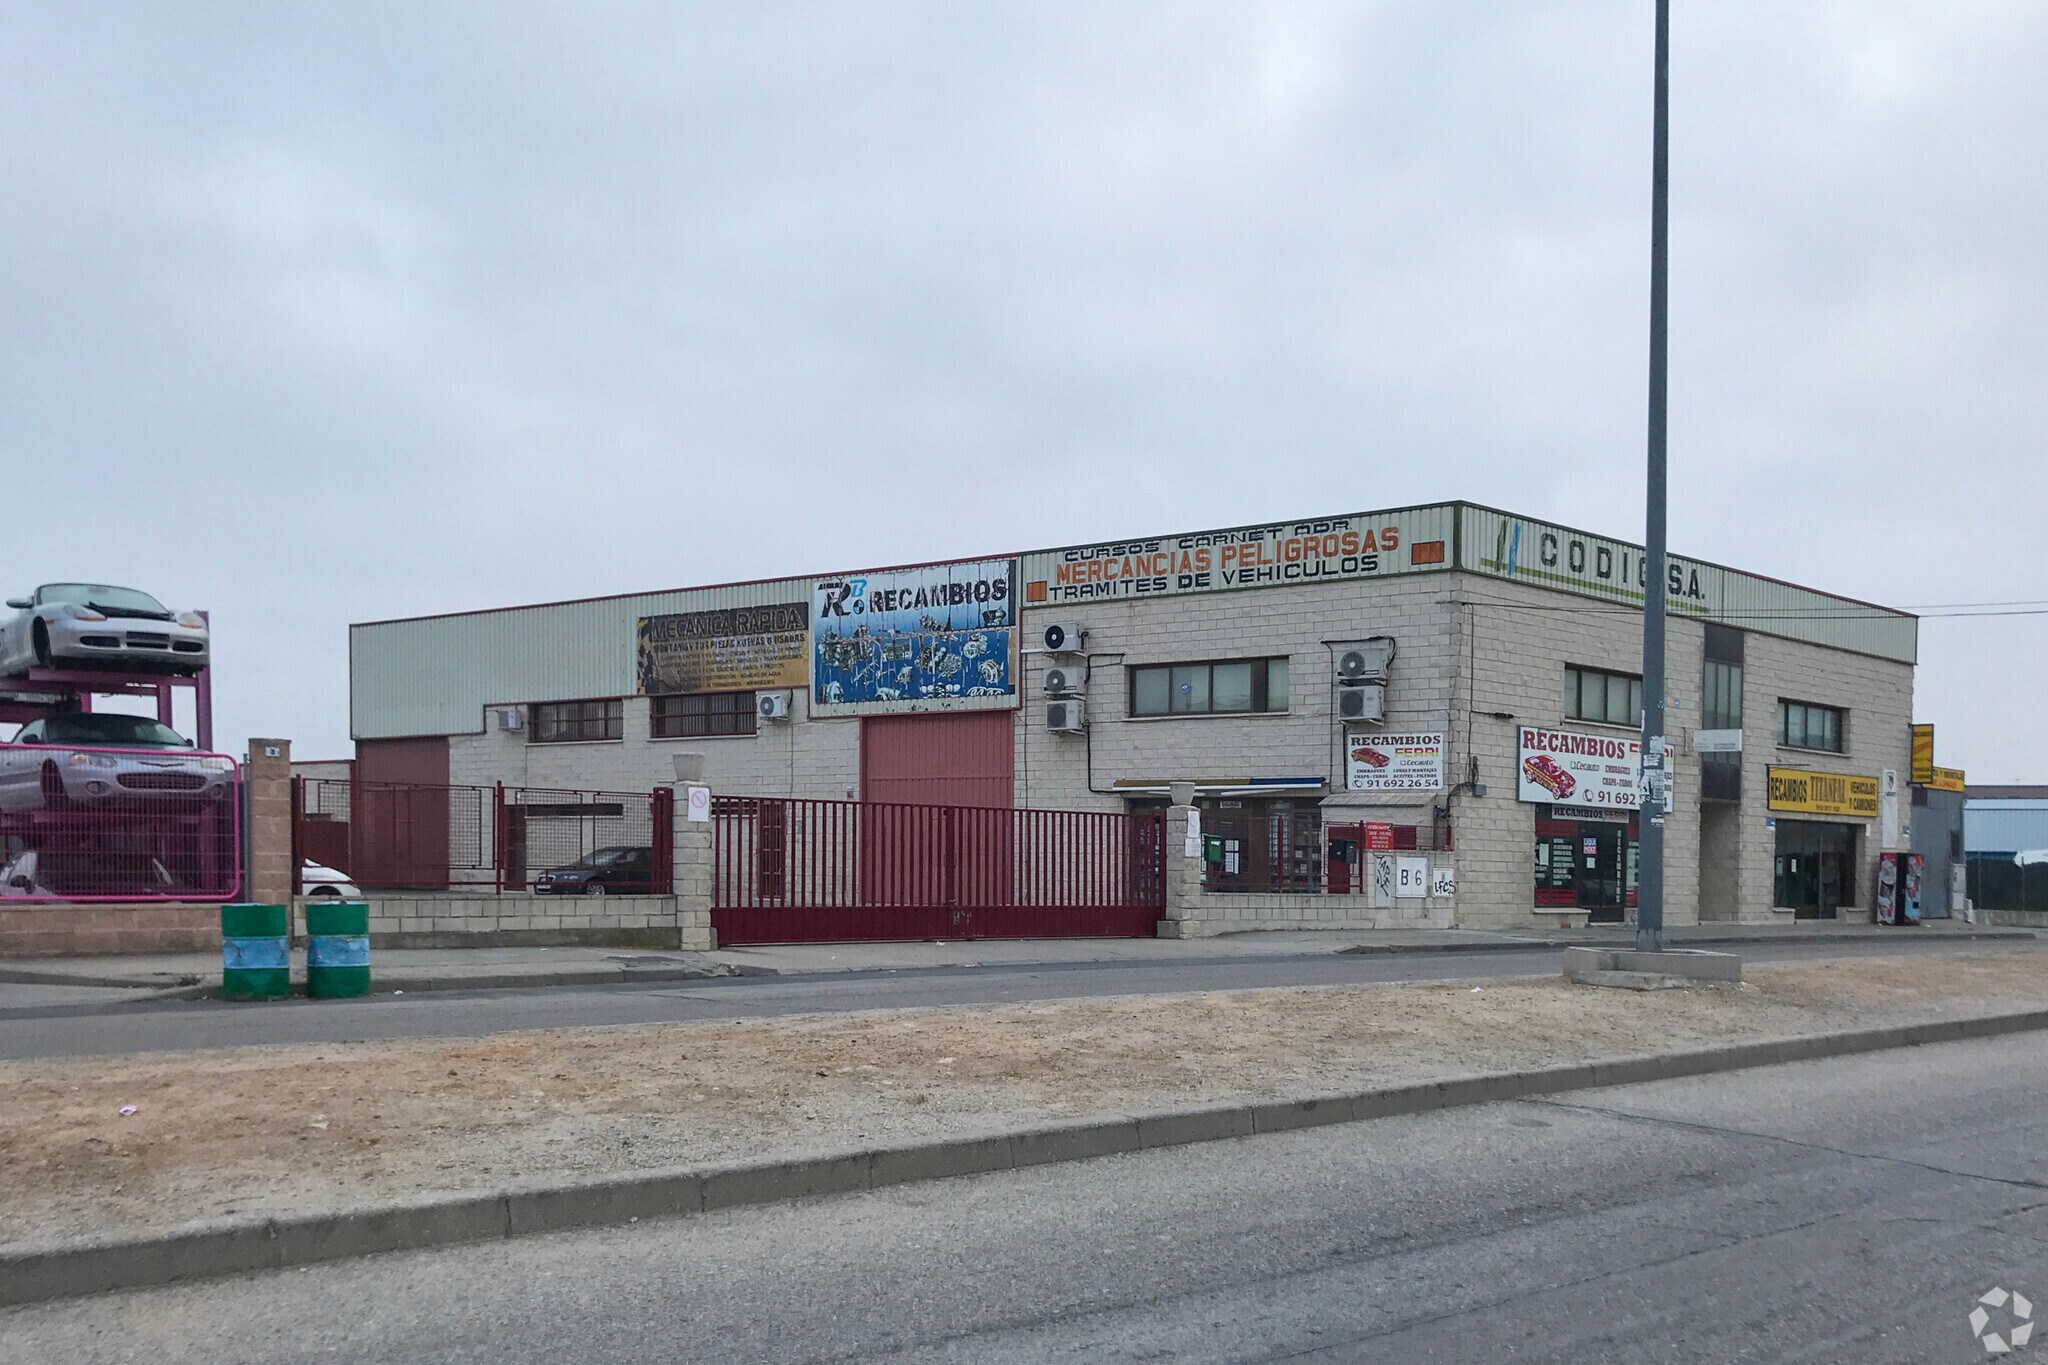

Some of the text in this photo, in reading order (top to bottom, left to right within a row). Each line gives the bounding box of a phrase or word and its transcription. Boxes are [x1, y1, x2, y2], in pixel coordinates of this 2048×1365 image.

[1064, 541, 1160, 563] CURSOS
[1178, 528, 1283, 550] CARNET
[1056, 526, 1399, 586] MERCANCIAS PELIGROSAS
[1049, 554, 1379, 601] TRAMITES DE VEHICULOS
[869, 578, 1007, 613] RECAMBIOS
[710, 637, 735, 649] PIEZAS
[774, 633, 805, 645] USADAS
[1350, 735, 1441, 747] RECAMBIOS
[1523, 730, 1625, 760] RECAMBIOS
[1395, 747, 1439, 758] FERRI
[1367, 779, 1439, 788] 91 692 26 54
[1770, 776, 1808, 804] RECAMBIOS
[1850, 781, 1876, 796] VEHICULOS
[1597, 790, 1636, 806] 91 692
[1853, 797, 1877, 812] CAMIONES
[1553, 807, 1603, 819] RECAMBIOS
[1400, 868, 1423, 886] B 6
